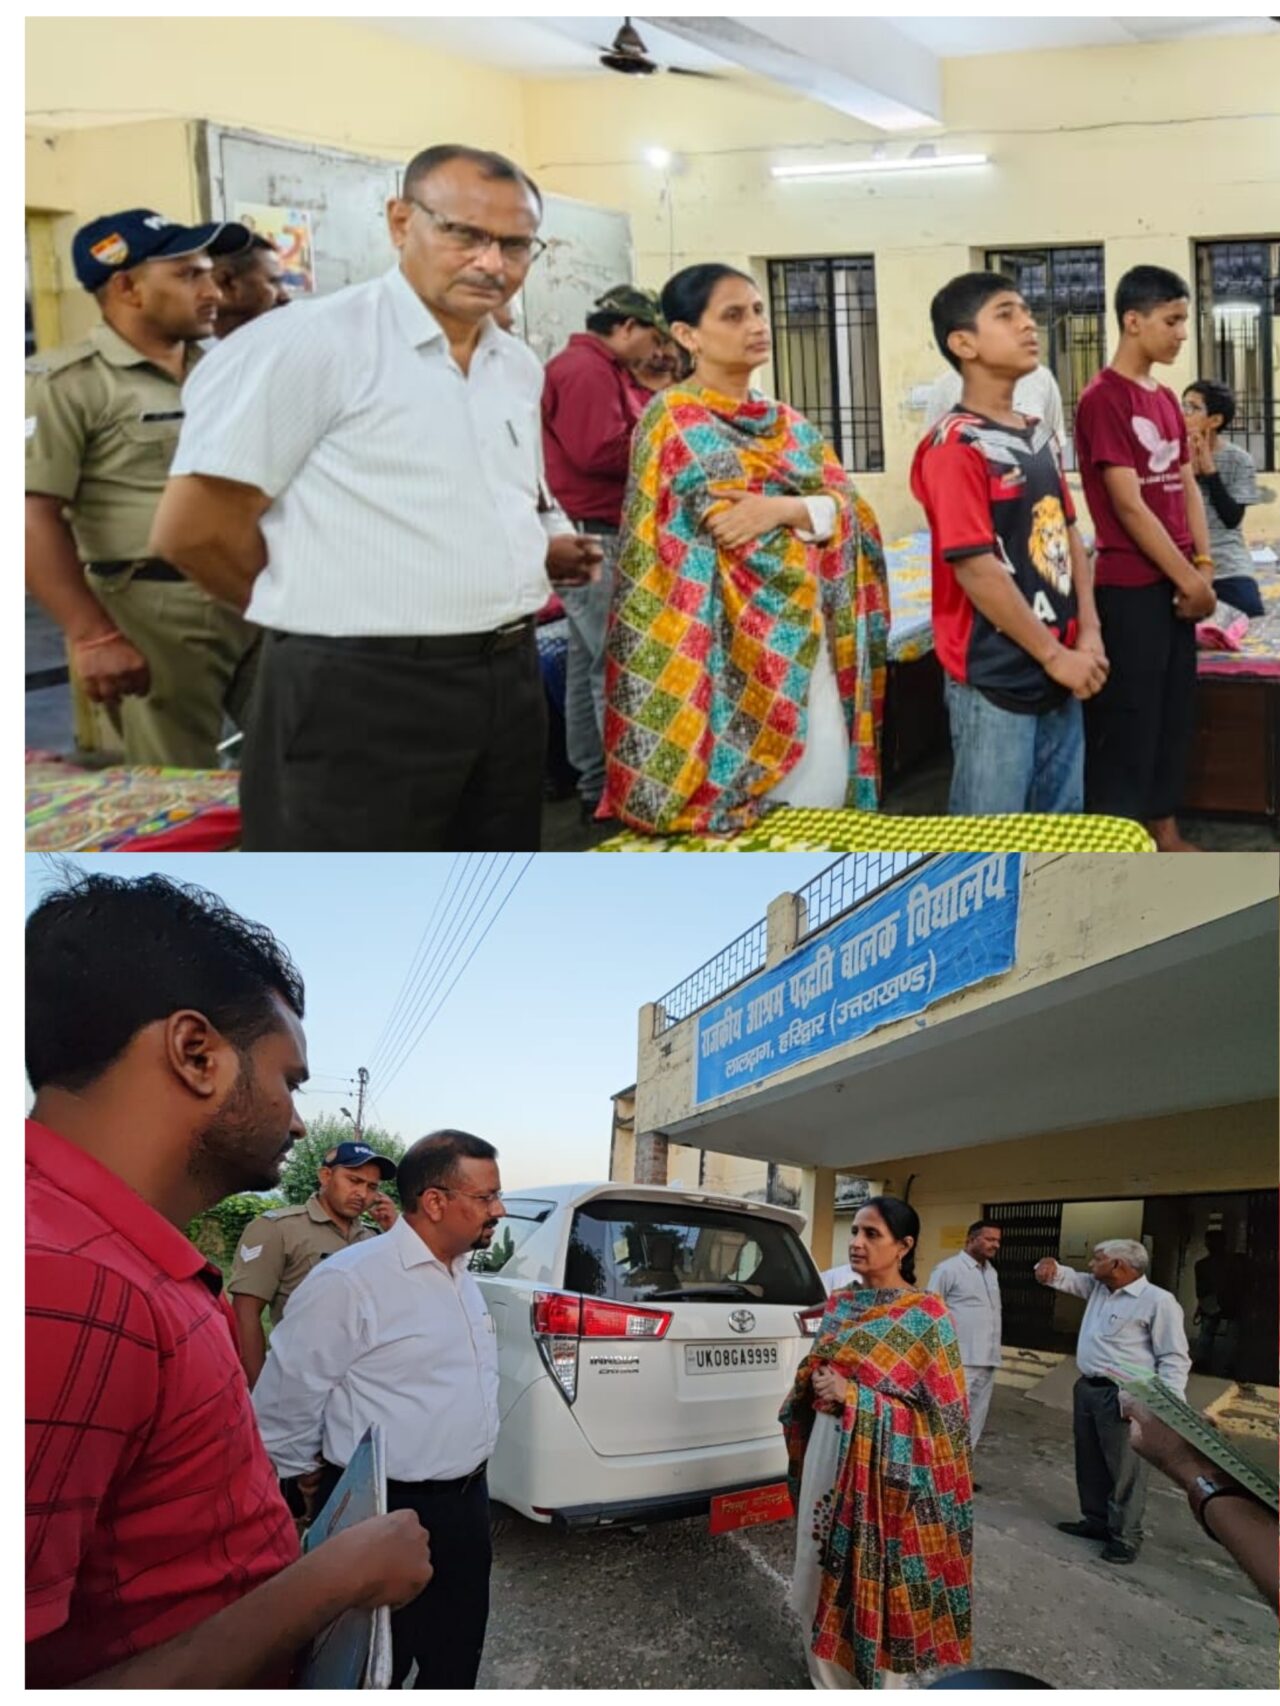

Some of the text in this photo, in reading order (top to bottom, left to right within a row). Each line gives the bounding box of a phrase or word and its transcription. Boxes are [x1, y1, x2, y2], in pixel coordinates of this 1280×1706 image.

[746, 981, 785, 1034] आश्रम
[839, 909, 900, 980] बालक
[907, 852, 1007, 947] विद्यालय
[778, 1011, 827, 1054] हरिद्वार
[696, 1347, 777, 1367] UK08GA9999
